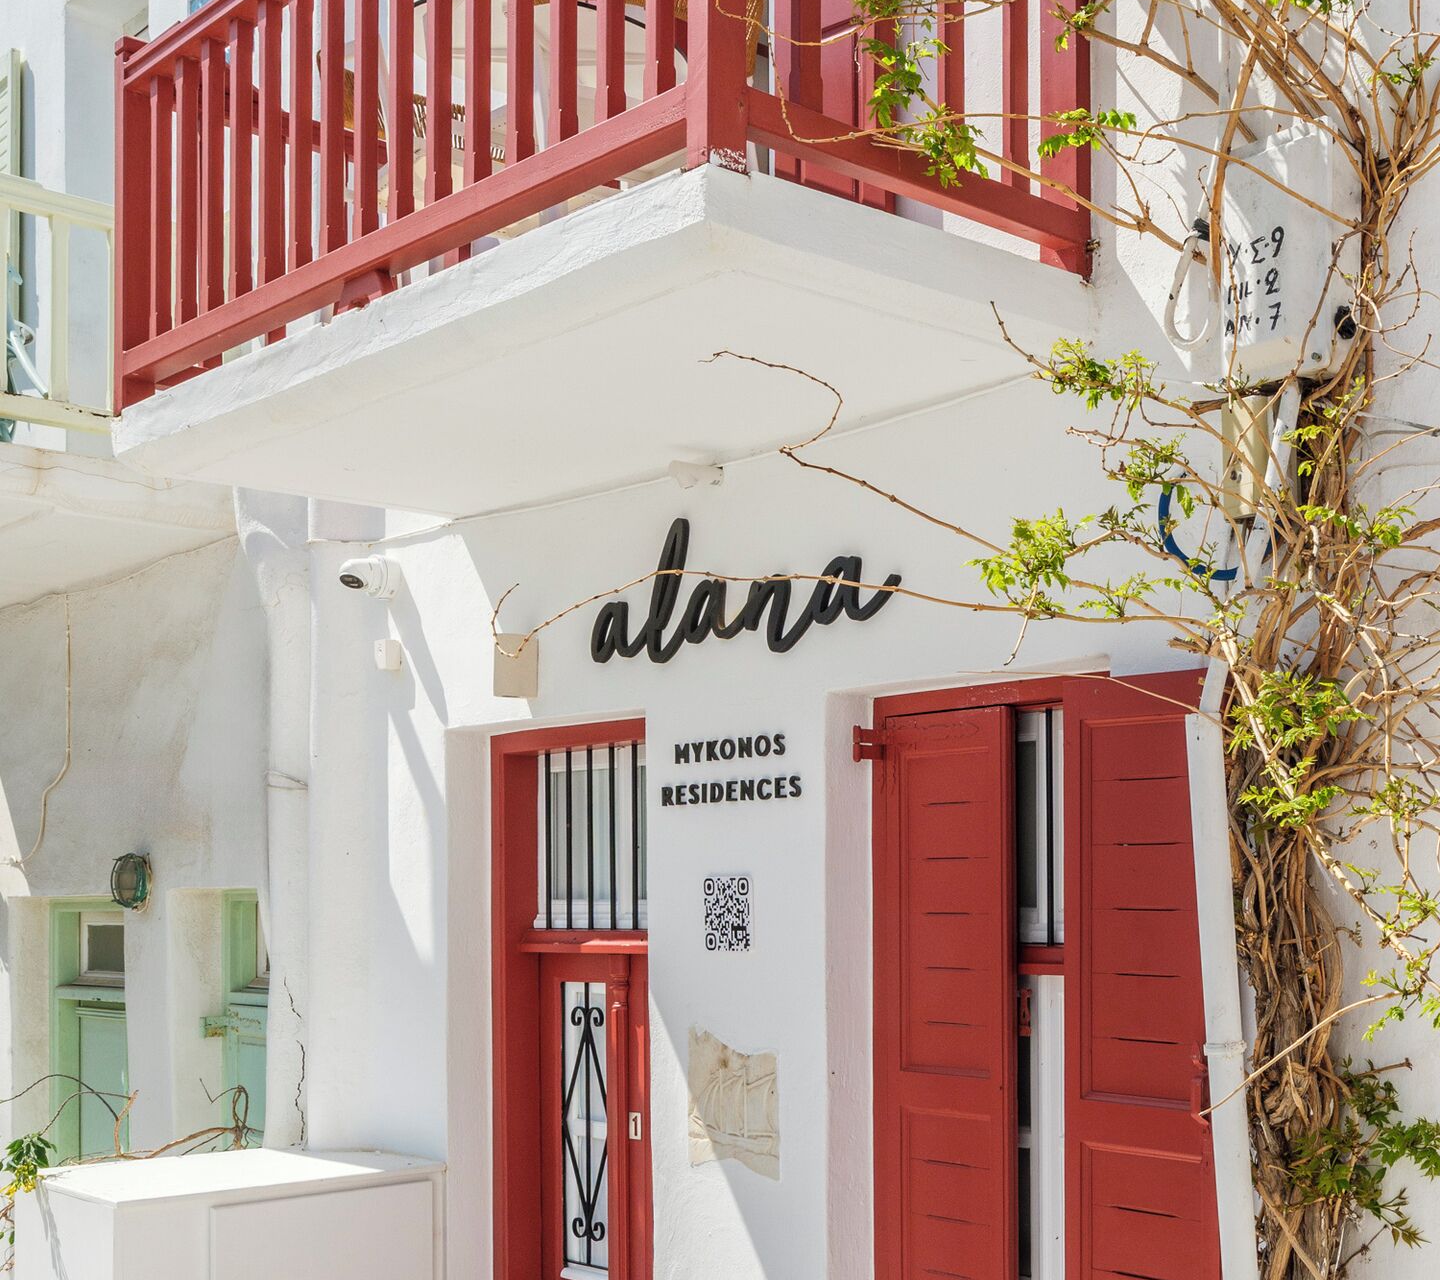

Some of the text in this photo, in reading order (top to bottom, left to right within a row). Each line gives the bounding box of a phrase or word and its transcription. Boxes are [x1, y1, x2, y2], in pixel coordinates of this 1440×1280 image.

[590, 517, 902, 664] alana
[674, 733, 786, 765] MYKONOS
[661, 775, 802, 807] RESIDENCES
[632, 1115, 638, 1137] 1
